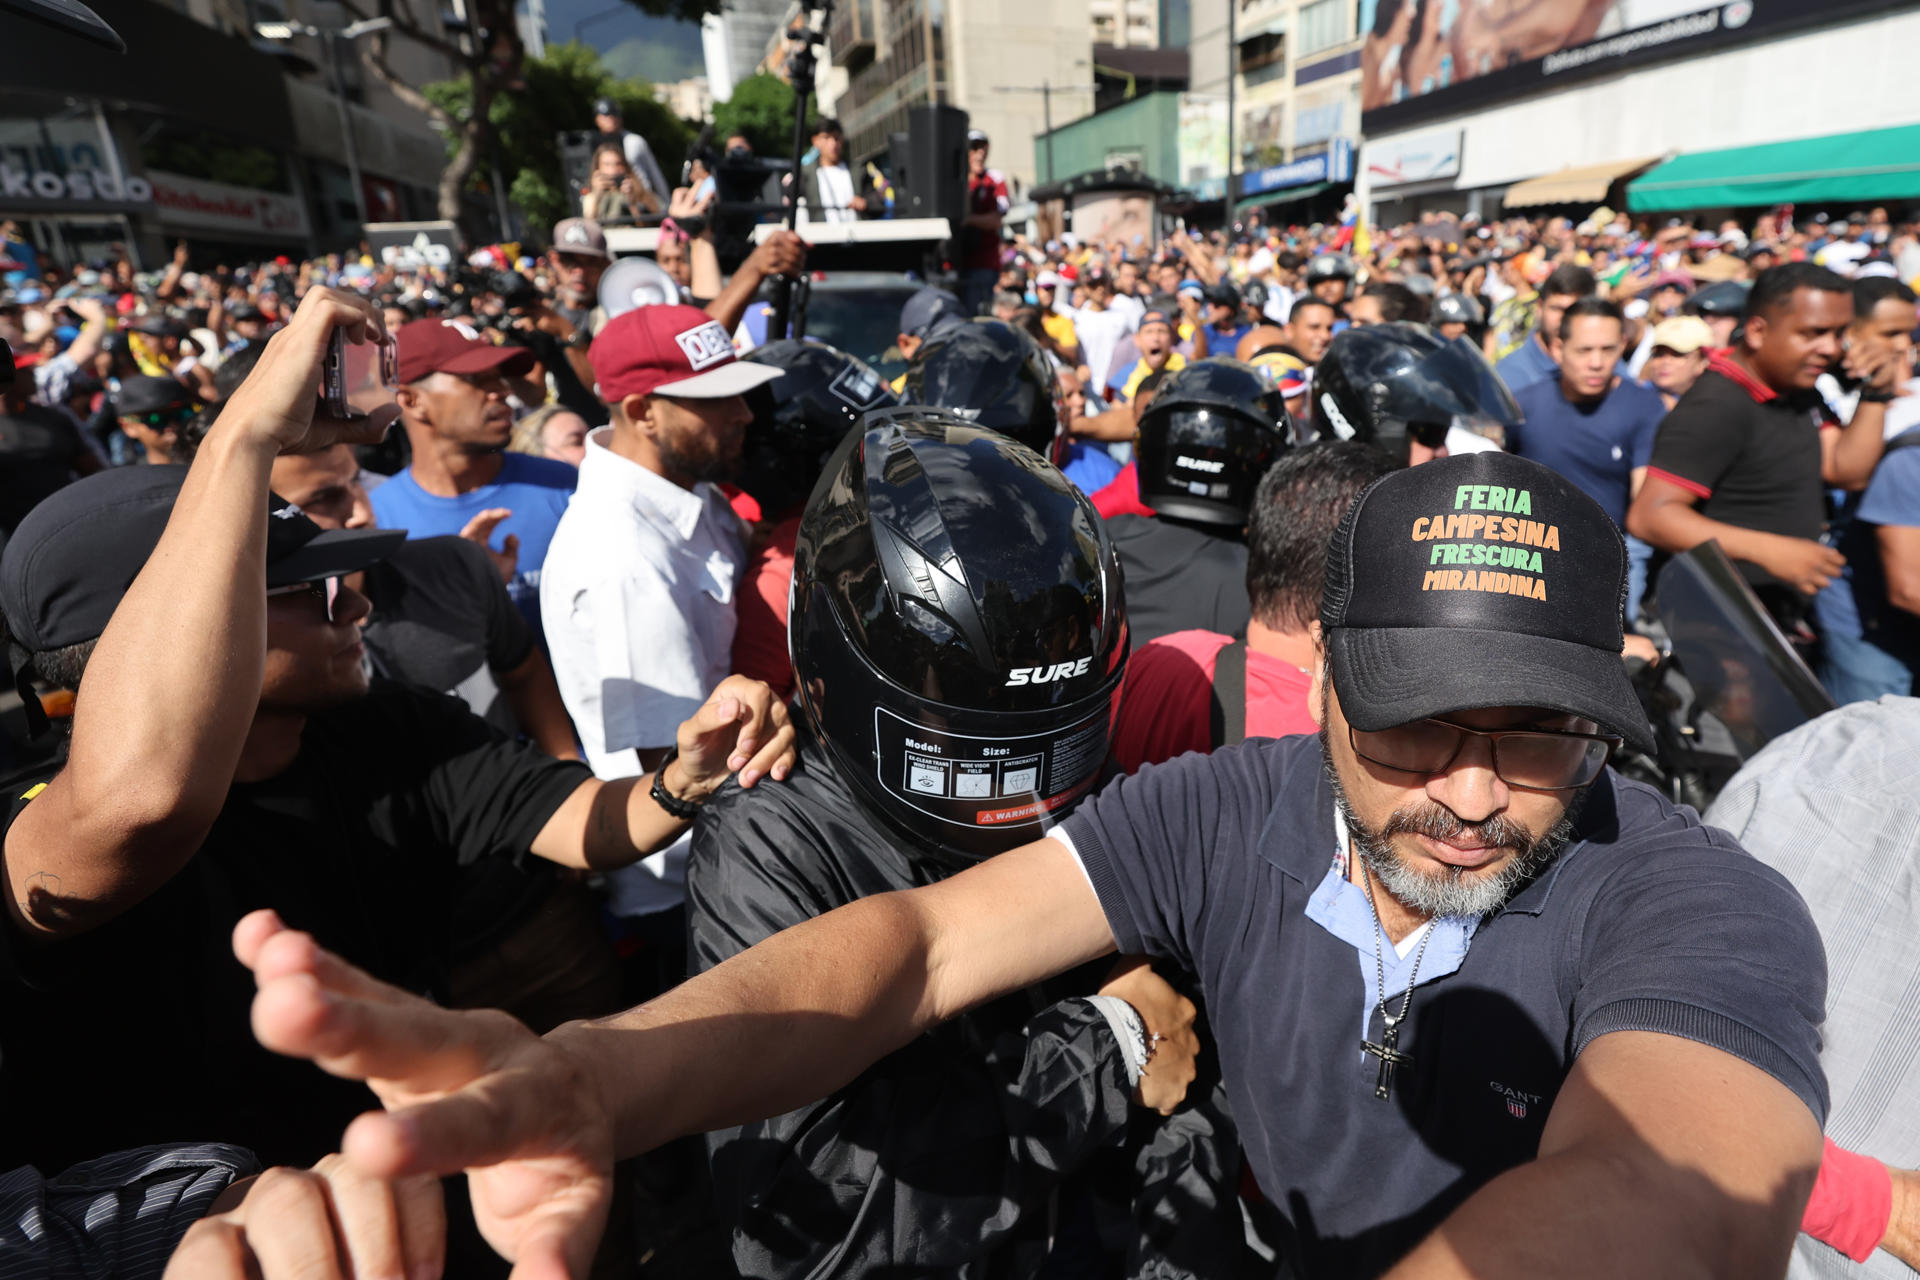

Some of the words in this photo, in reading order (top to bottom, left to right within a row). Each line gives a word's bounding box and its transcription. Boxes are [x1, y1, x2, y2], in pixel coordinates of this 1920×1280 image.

[1176, 456, 1224, 473] SURE
[1454, 485, 1531, 515] FERIA
[1412, 514, 1560, 551] CAMPESINA
[1430, 544, 1543, 573] FRESCURA
[1422, 570, 1547, 601] MIRANDINA
[1005, 656, 1092, 686] SURE
[905, 738, 942, 753] Model:
[983, 748, 1010, 756] Size:
[1004, 757, 1038, 767] ANTISCRATCH
[996, 804, 1044, 820] WARNING
[1489, 1081, 1542, 1105] GANT
